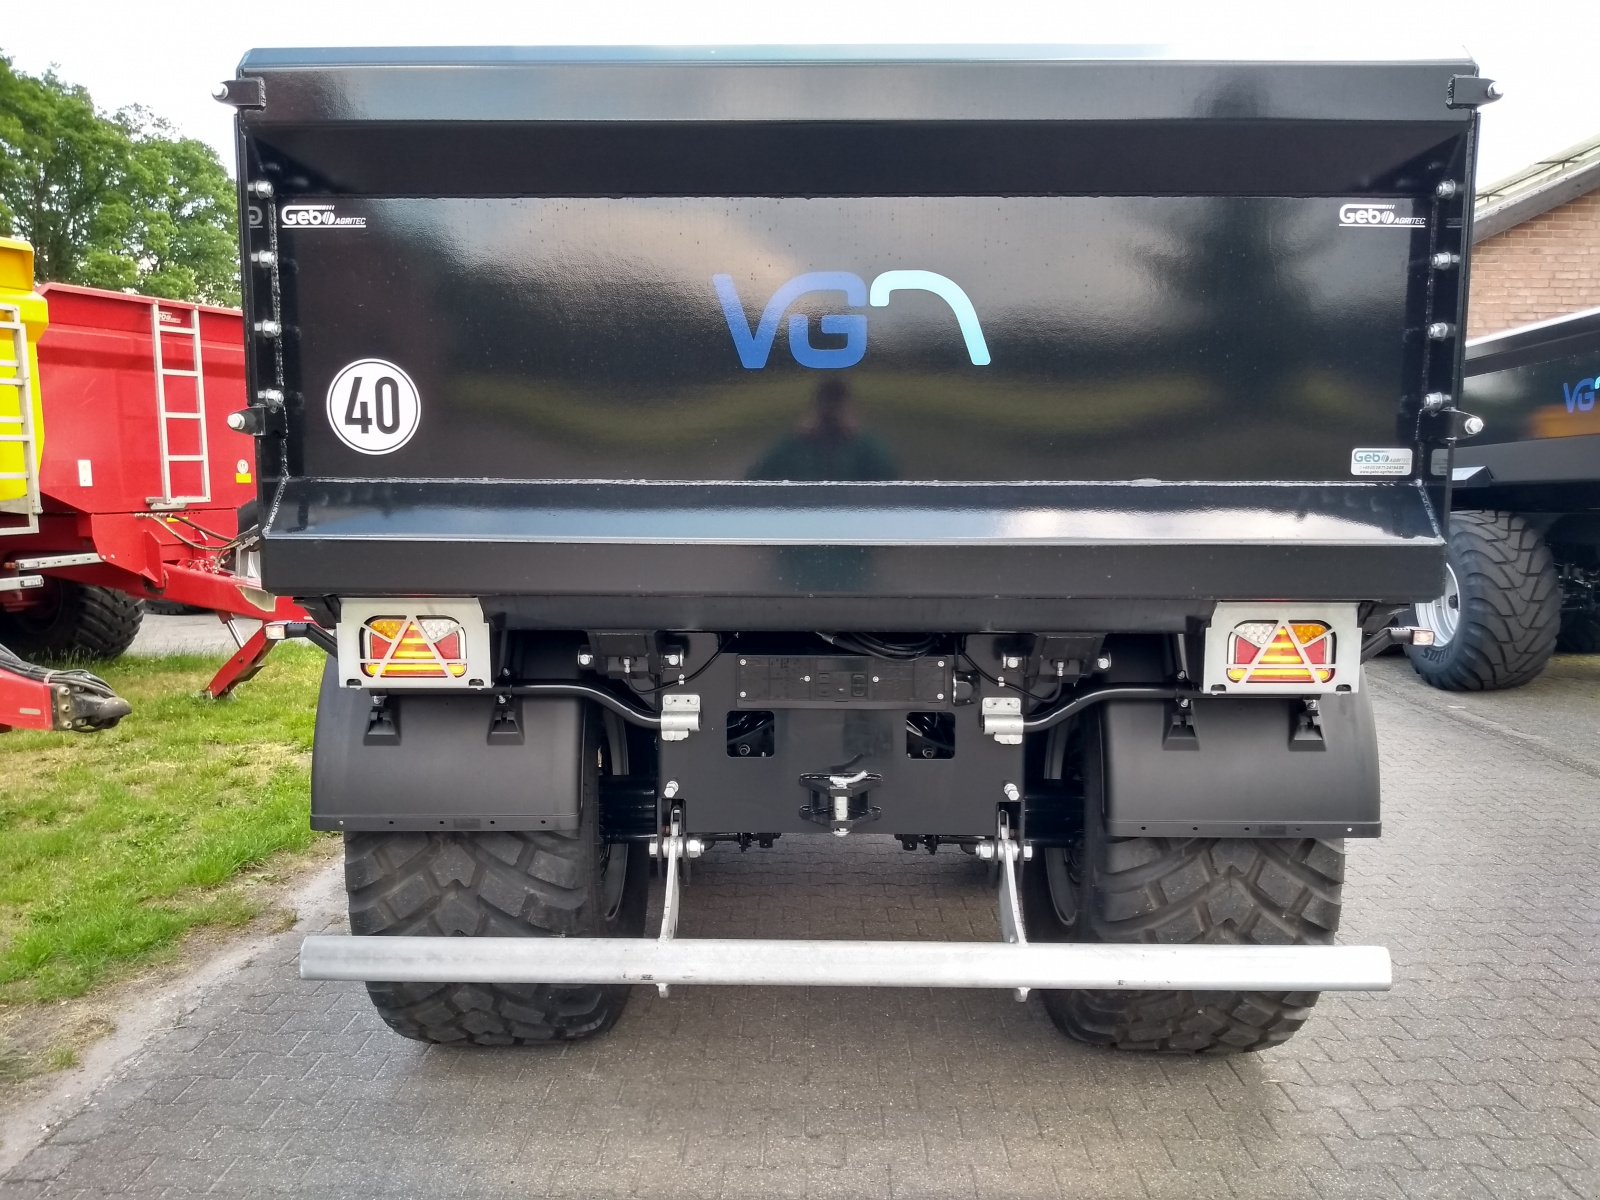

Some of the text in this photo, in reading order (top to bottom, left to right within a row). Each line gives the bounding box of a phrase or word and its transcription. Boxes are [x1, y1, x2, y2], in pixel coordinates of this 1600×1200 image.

[281, 205, 367, 225] Gebo AGRITEC
[1339, 204, 1426, 225] Gebo AGRITEC
[344, 376, 400, 434] 40
